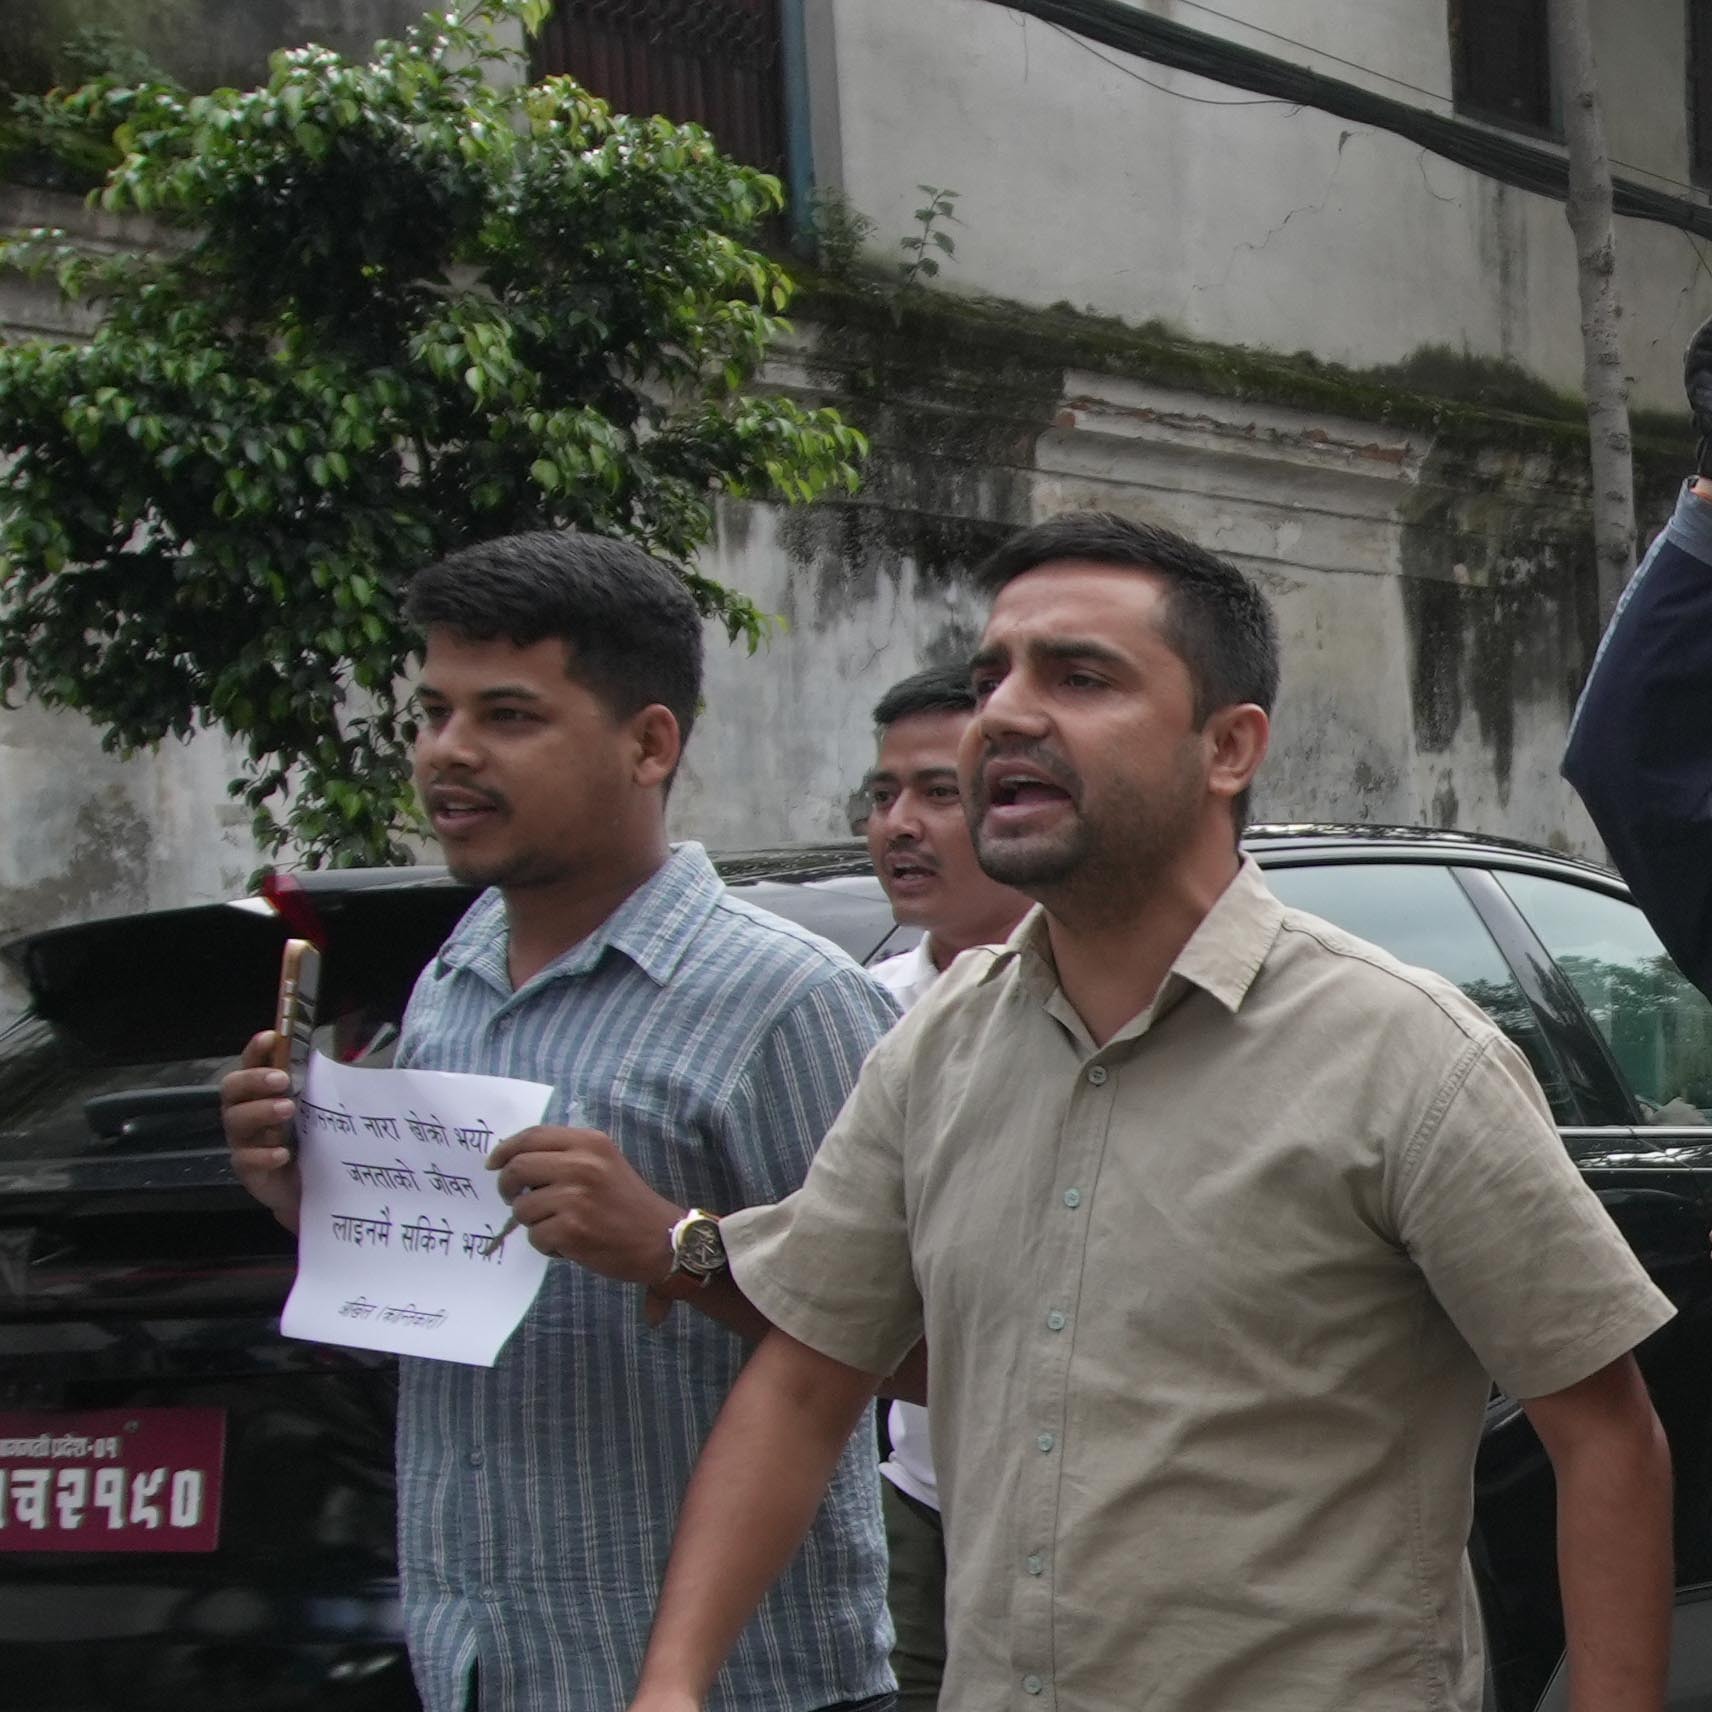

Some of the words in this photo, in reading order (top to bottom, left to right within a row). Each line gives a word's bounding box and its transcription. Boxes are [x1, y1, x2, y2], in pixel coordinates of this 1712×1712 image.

[342, 1158, 421, 1192] जनताको
[423, 1162, 481, 1201] जीवन
[331, 1205, 392, 1247] लाइनमै
[400, 1215, 454, 1256] सकिने
